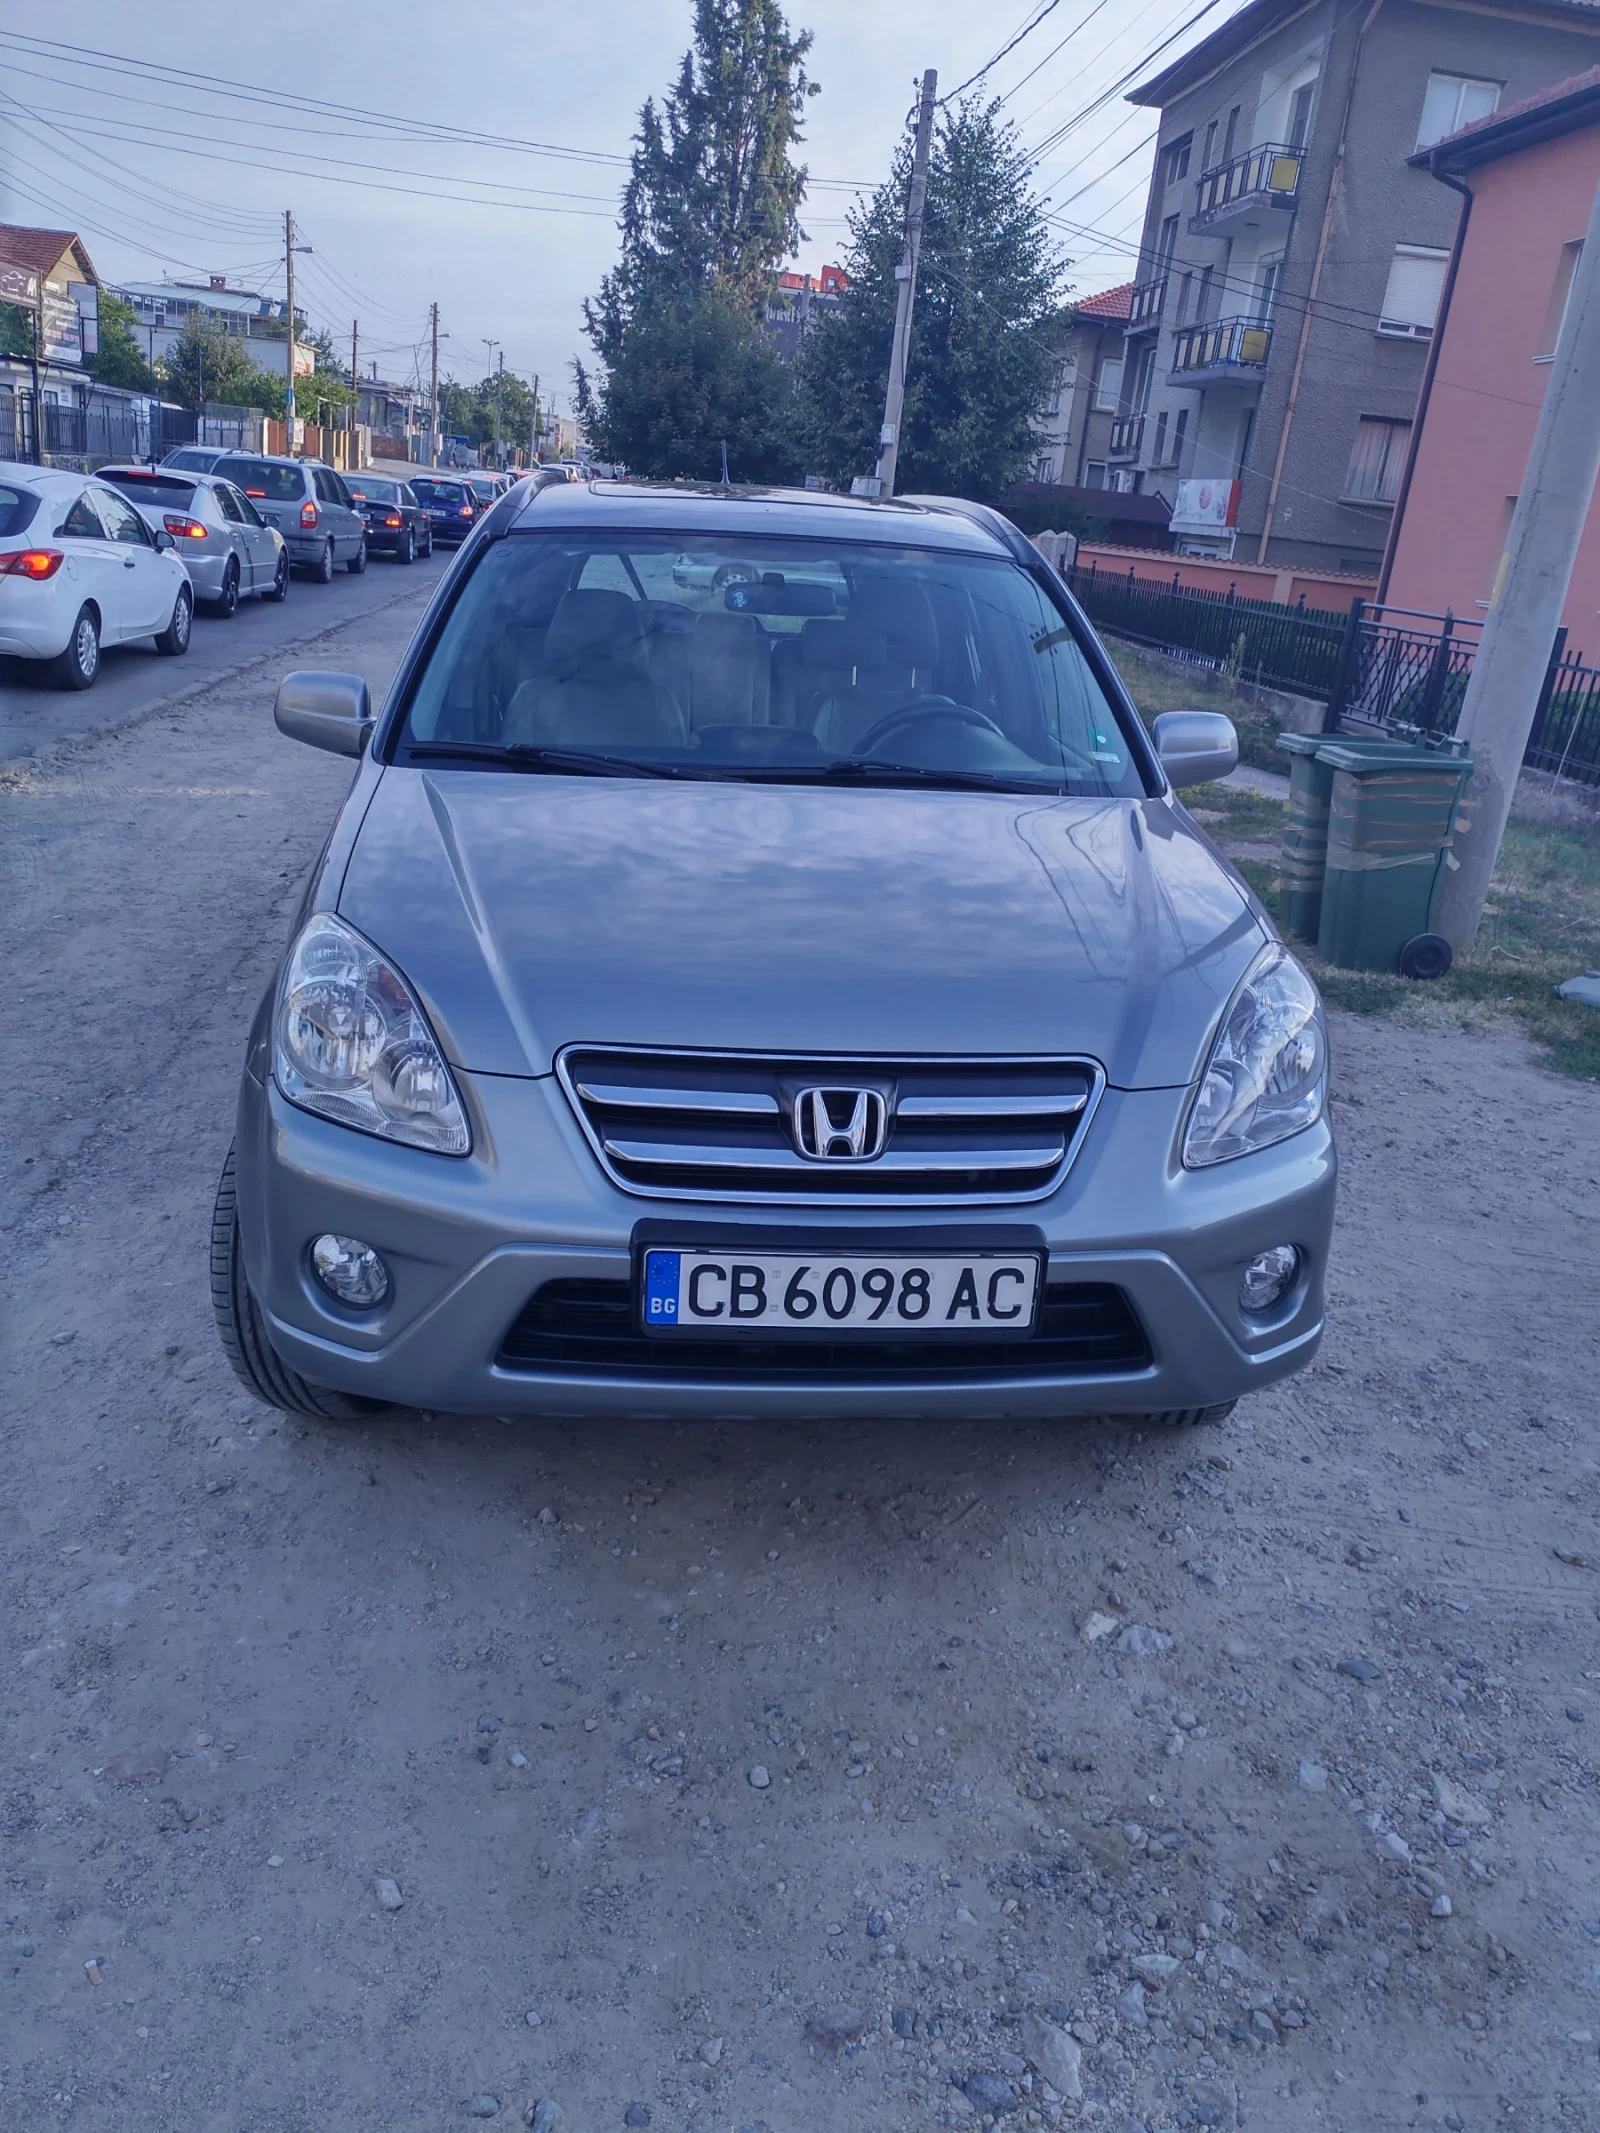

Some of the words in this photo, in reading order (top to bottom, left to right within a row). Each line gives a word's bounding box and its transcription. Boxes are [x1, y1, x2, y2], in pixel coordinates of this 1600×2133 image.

[650, 1298, 676, 1315] BG
[689, 1263, 767, 1318] CB
[783, 1266, 932, 1320] 6098
[946, 1268, 1026, 1321] AC
